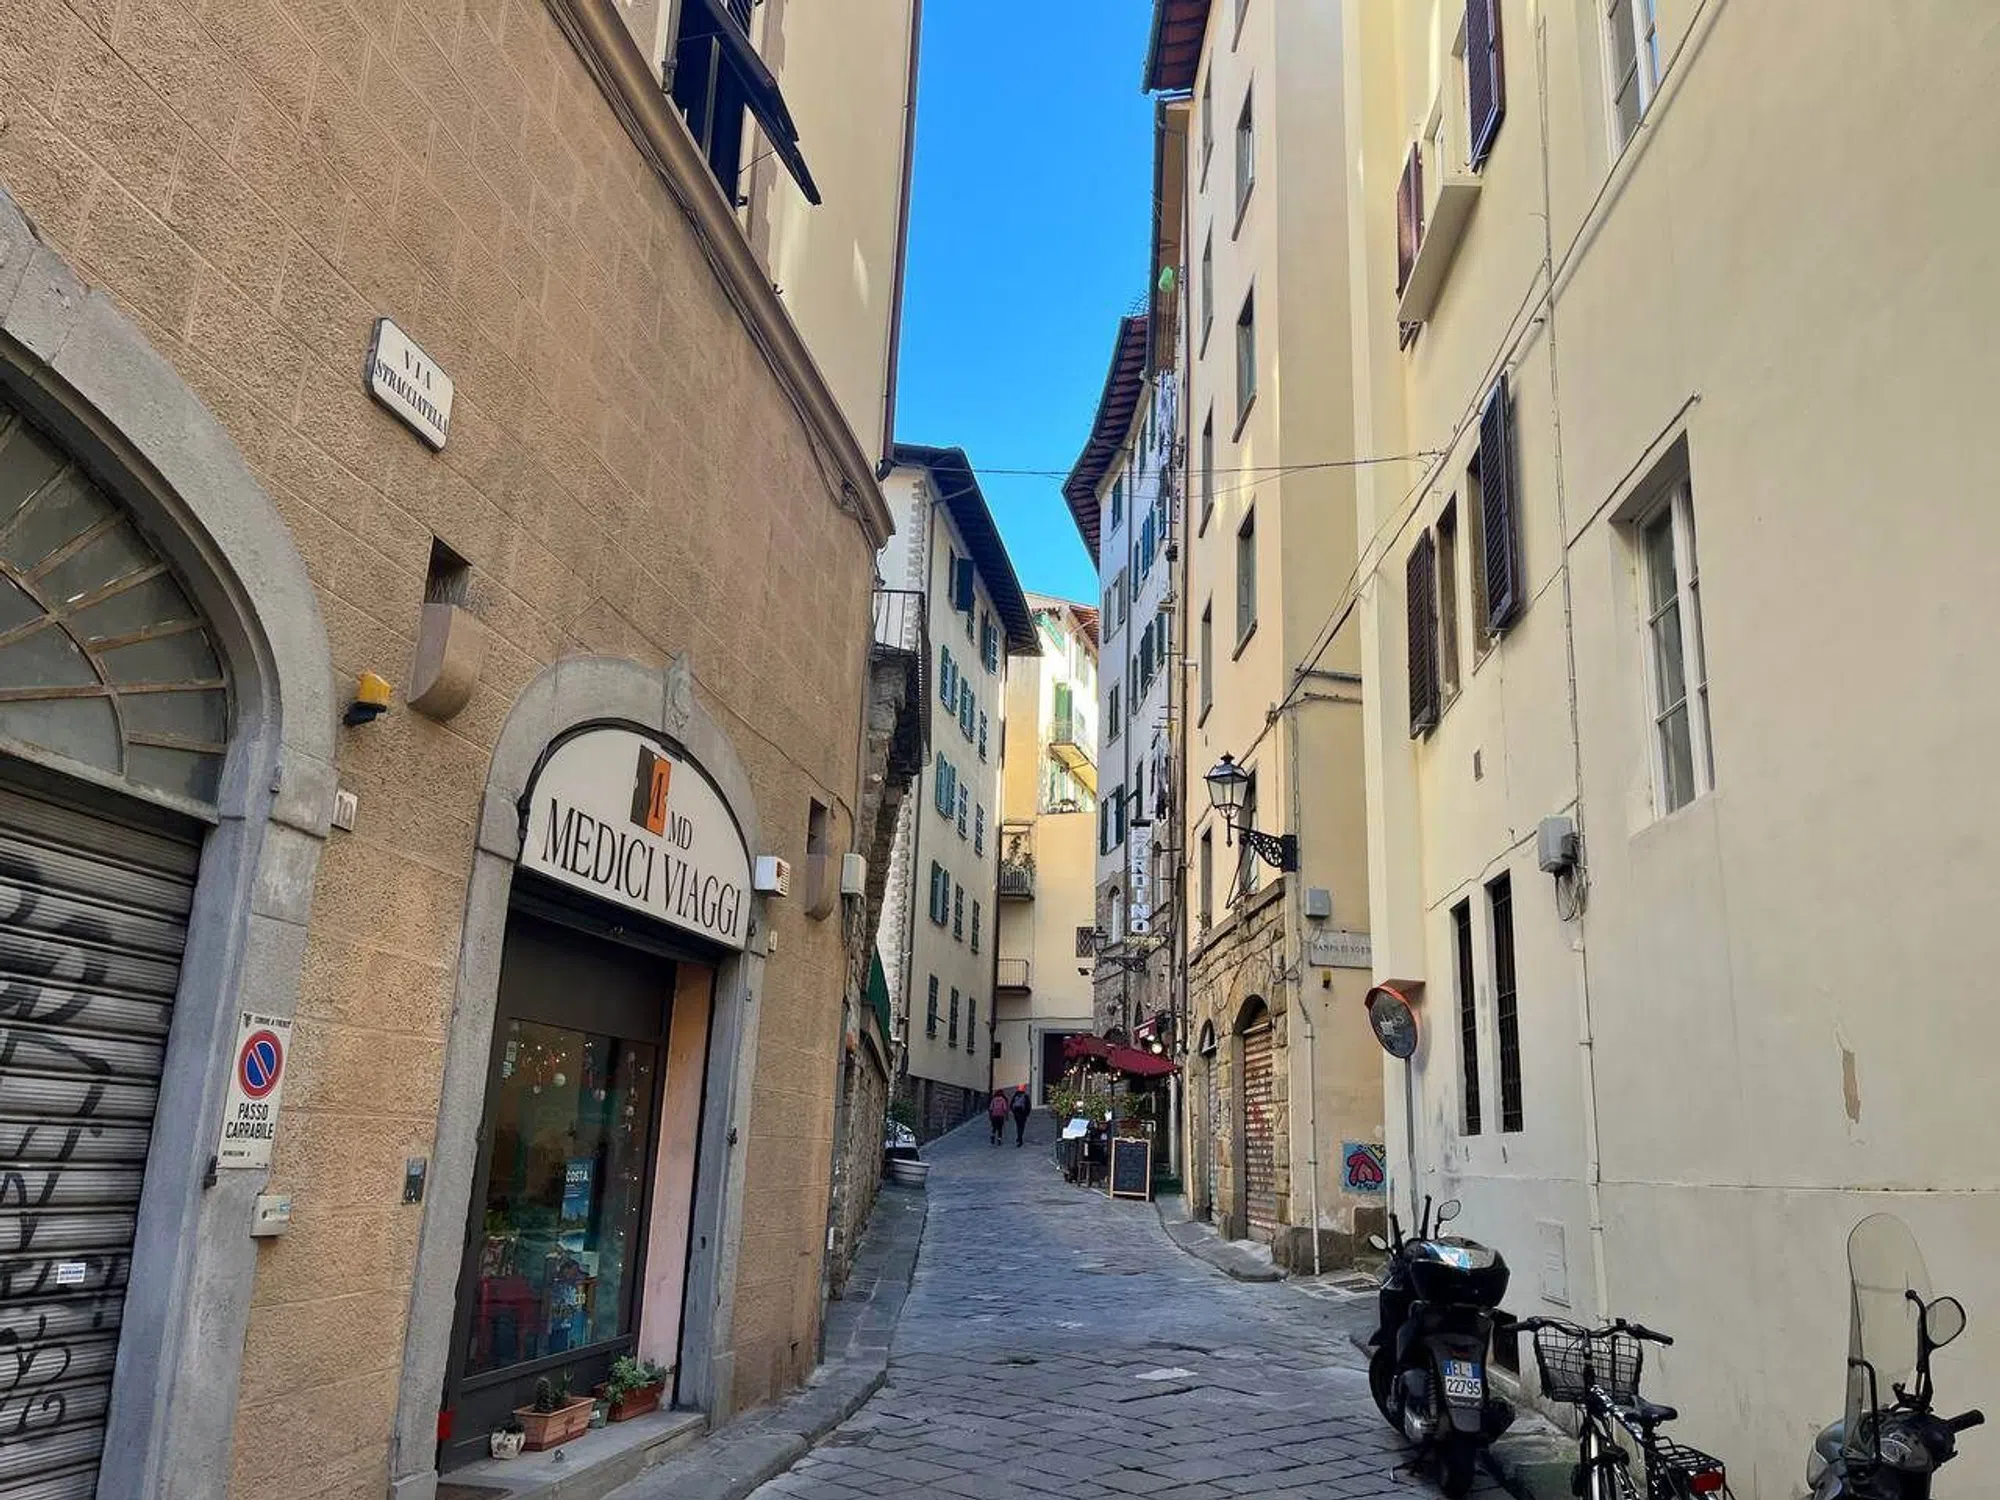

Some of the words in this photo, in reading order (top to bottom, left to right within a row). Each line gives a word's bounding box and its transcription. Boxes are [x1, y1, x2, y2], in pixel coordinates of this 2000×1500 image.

[404, 350, 431, 390] VIA
[374, 358, 449, 436] STRACCIATELLA
[667, 811, 693, 850] MD
[541, 798, 656, 903] MEDICI
[664, 853, 742, 938] VIAGGI
[225, 1121, 274, 1140] CARRABILE
[237, 1103, 269, 1121] PASSO
[1446, 1378, 1481, 1396] 22795
